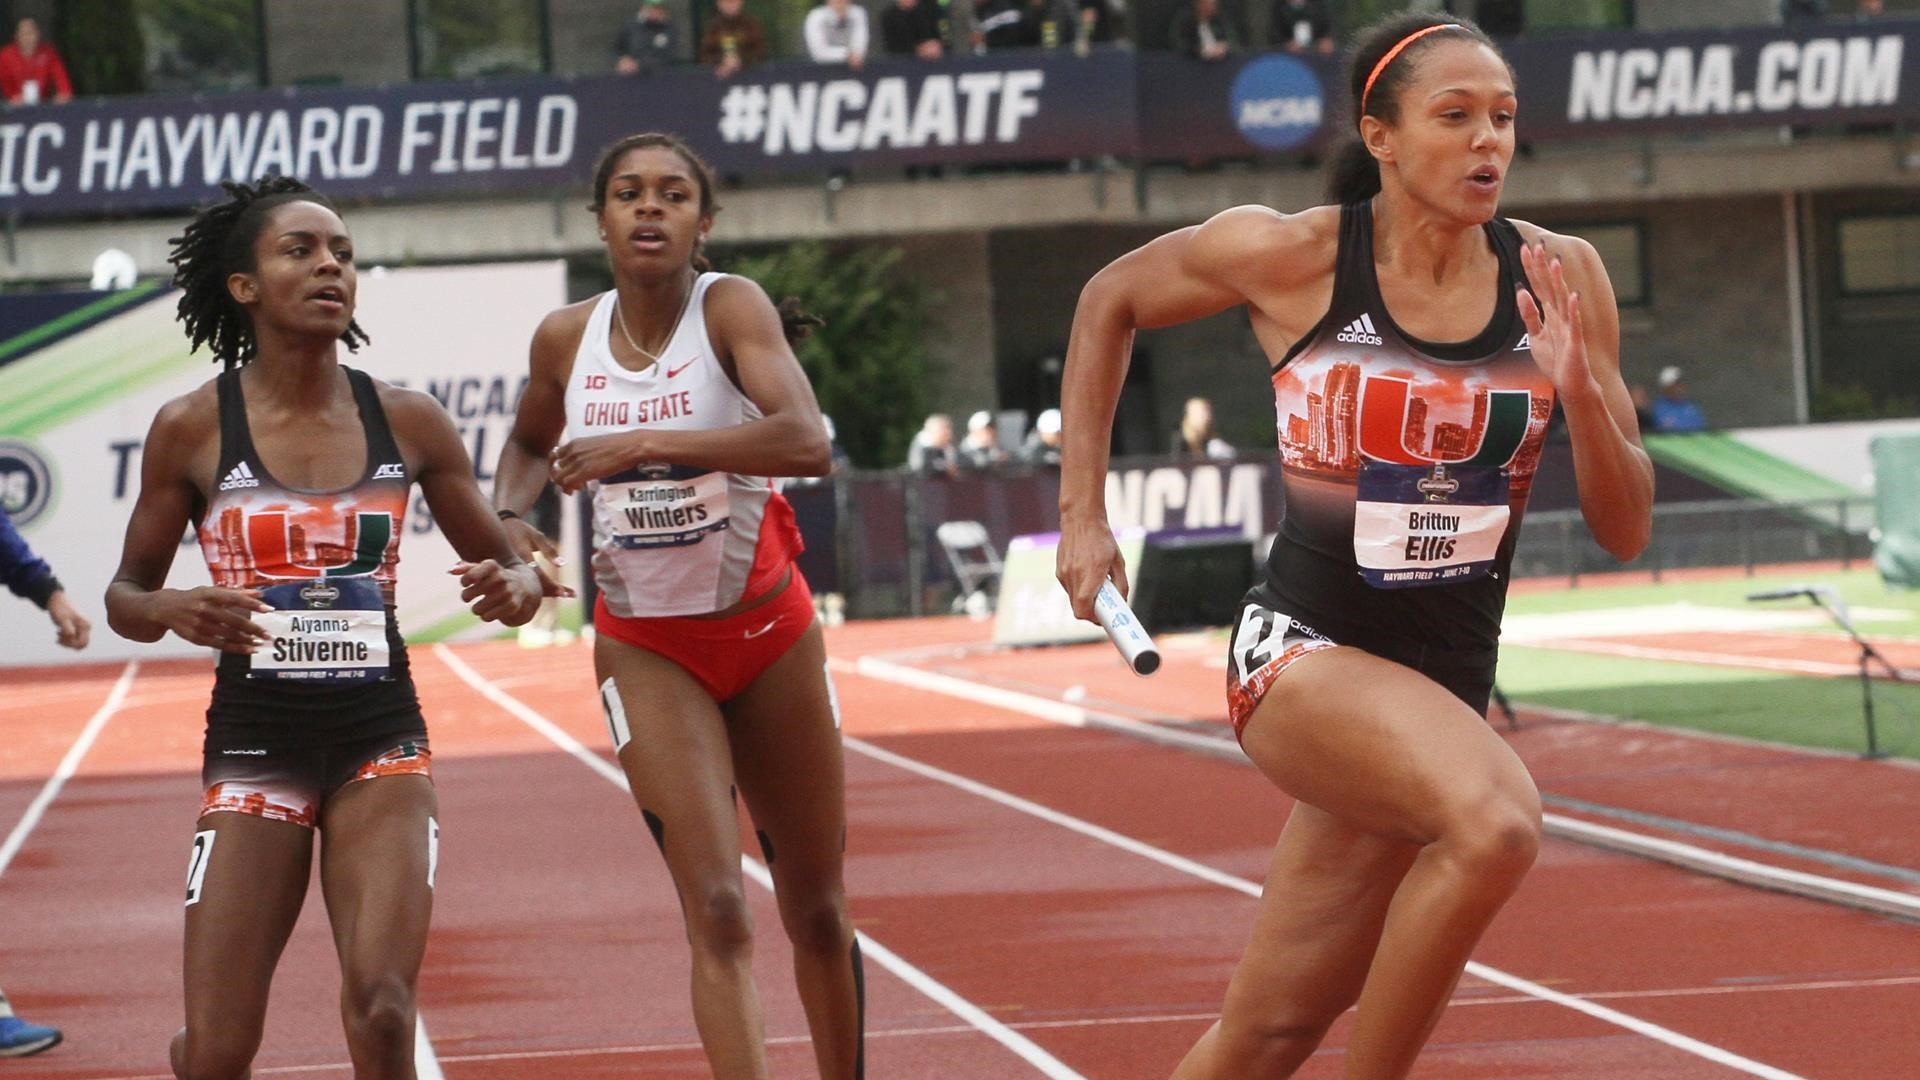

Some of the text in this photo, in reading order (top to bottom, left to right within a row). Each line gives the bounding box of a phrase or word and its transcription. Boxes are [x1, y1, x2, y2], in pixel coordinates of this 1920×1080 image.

[1567, 34, 1904, 123] NCAA.COM
[718, 69, 1044, 156] #NCAATF
[79, 106, 384, 193] HAYWARD
[398, 94, 578, 176] FIELD
[1337, 331, 1383, 346] adidas
[584, 390, 693, 426] OHIO STATE
[373, 463, 404, 478] ACC
[219, 477, 259, 491] adidas
[628, 485, 696, 502] Karrington
[624, 503, 708, 530] Winters
[1409, 511, 1460, 533] Brittny
[1405, 535, 1457, 562] Ellis
[1383, 571, 1414, 581] HAYWARD
[1414, 570, 1434, 580] FIELD
[1441, 567, 1458, 578] JUNE
[291, 616, 350, 634] Aiyanna
[272, 636, 368, 663] Stiverne
